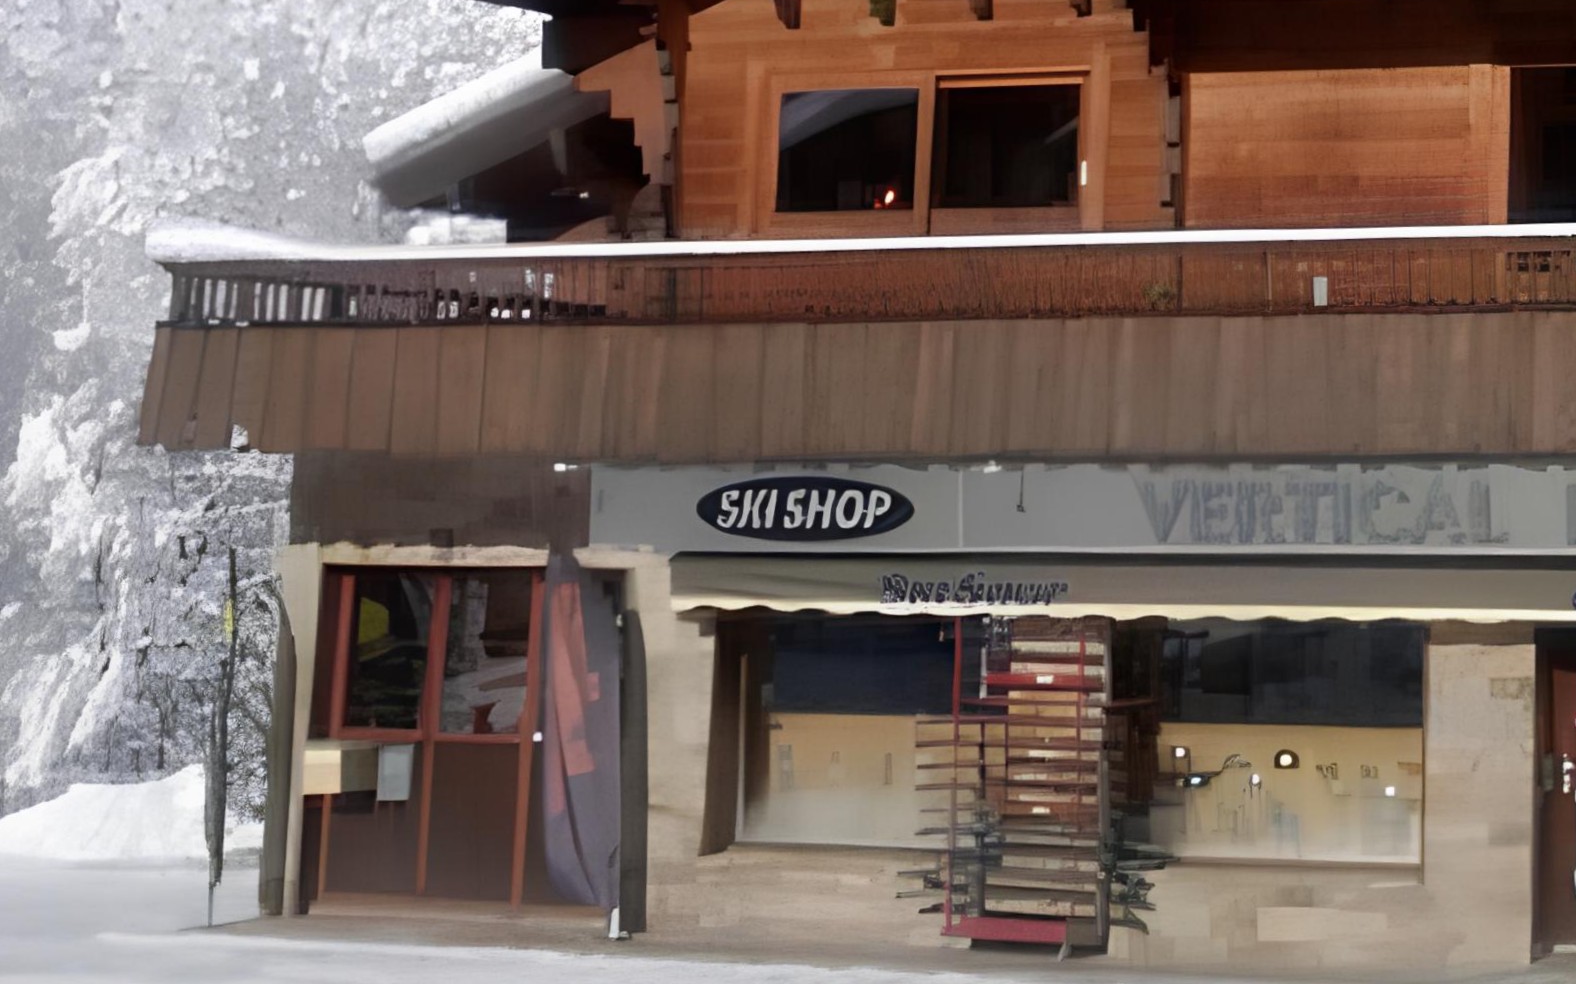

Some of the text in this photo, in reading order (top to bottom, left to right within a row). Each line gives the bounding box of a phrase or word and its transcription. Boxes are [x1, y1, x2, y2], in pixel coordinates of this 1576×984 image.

[716, 489, 892, 529] SKI SHOP
[1134, 478, 1508, 545] VERTICAL
